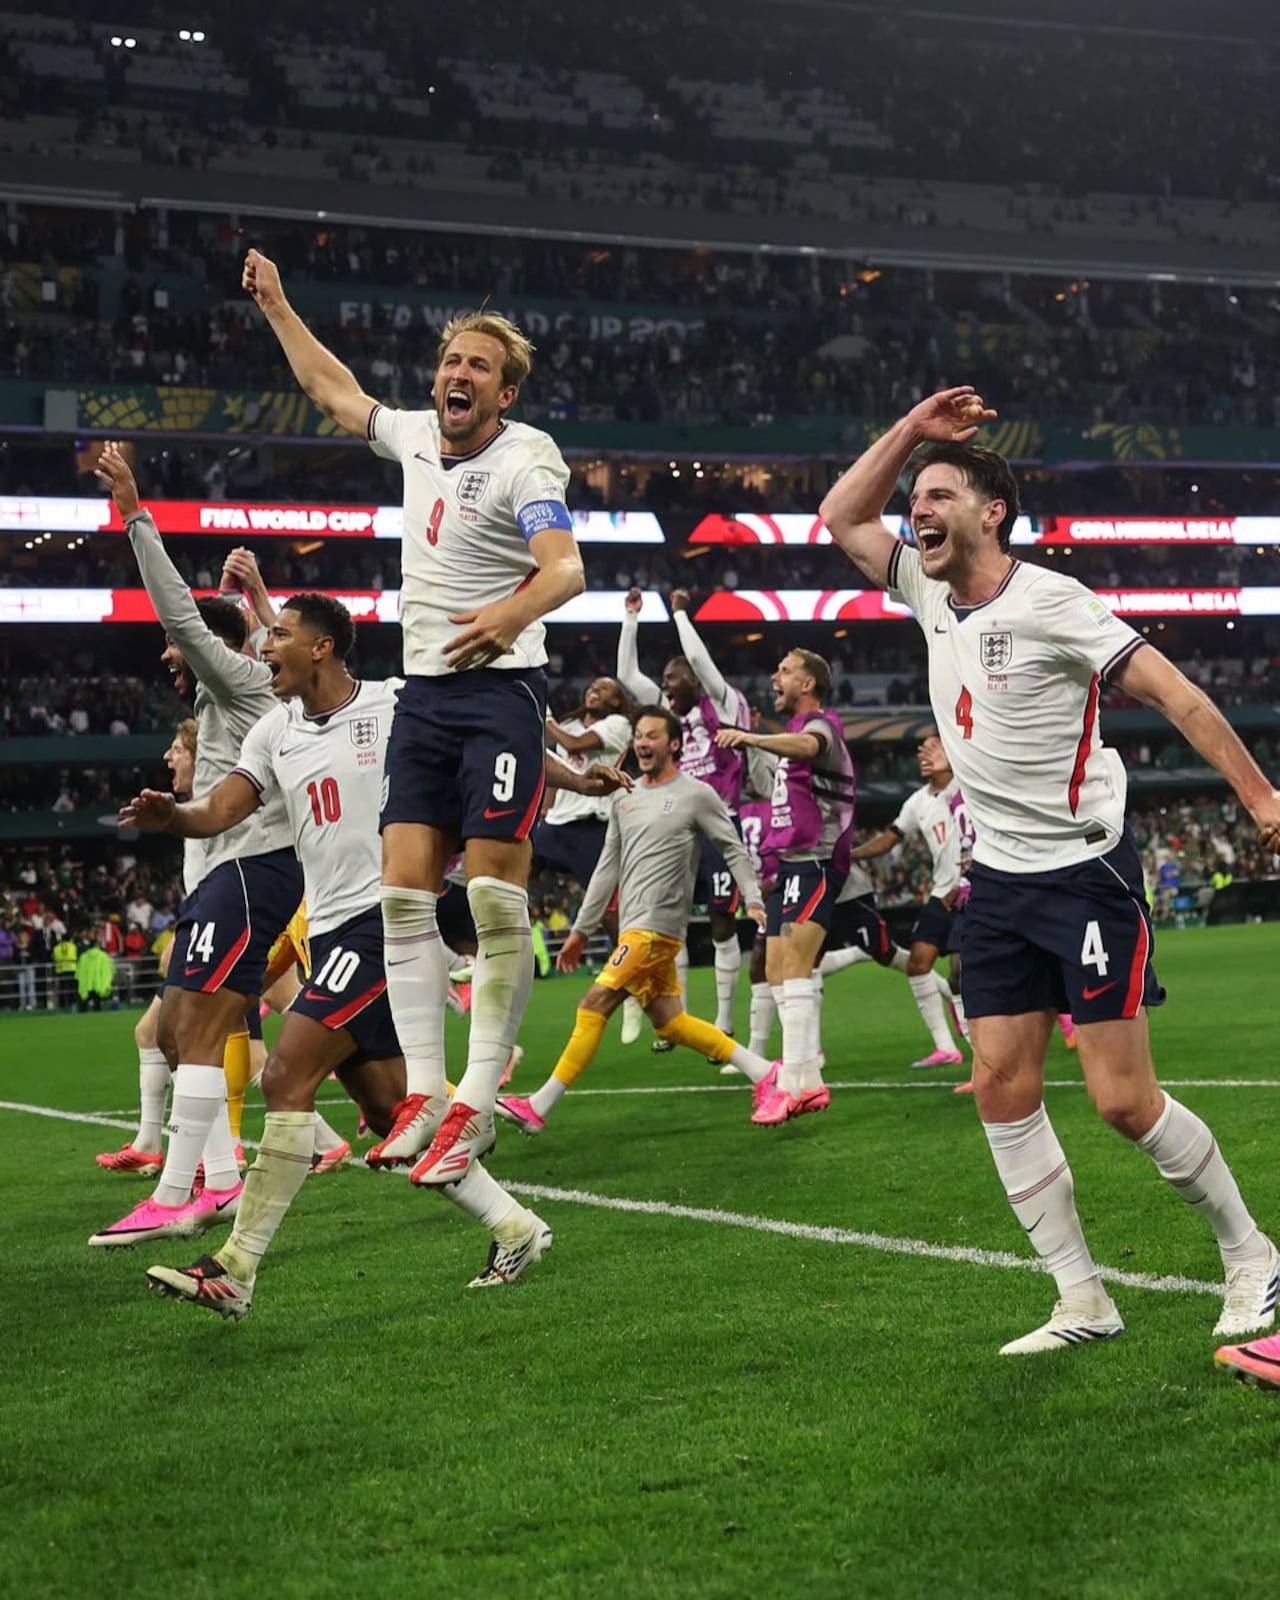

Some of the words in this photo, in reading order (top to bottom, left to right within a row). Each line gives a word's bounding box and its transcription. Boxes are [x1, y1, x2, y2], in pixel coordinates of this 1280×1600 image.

[200, 508, 249, 528] FIFA
[249, 510, 328, 531] WORLD
[328, 512, 371, 531] CUP
[427, 498, 444, 546] 9
[1210, 522, 1232, 539] LA
[335, 596, 375, 616] UP
[956, 684, 974, 739] 4
[492, 752, 517, 802] 9
[307, 777, 341, 826] 10
[932, 821, 946, 845] 17
[712, 872, 732, 897] 12
[186, 921, 216, 963] 24
[1081, 920, 1109, 976] 4
[314, 946, 361, 993] 10
